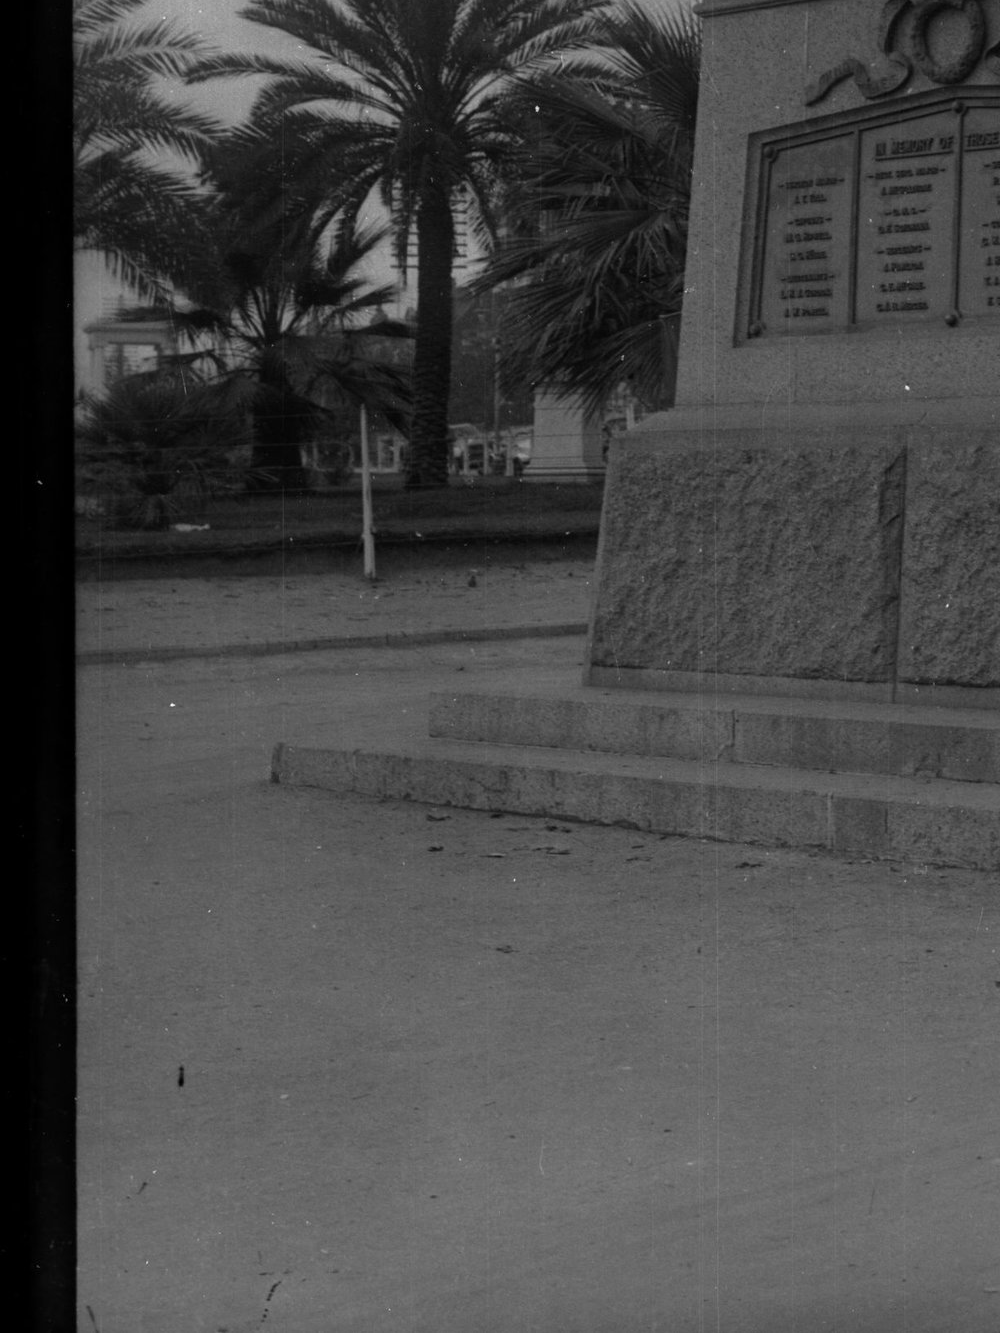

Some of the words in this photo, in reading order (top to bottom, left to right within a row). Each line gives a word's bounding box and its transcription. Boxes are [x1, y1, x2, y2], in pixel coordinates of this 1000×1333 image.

[875, 142, 886, 157] IN
[891, 137, 934, 155] MEMORY
[939, 135, 955, 150] OF
[966, 131, 1000, 148] THOSE
